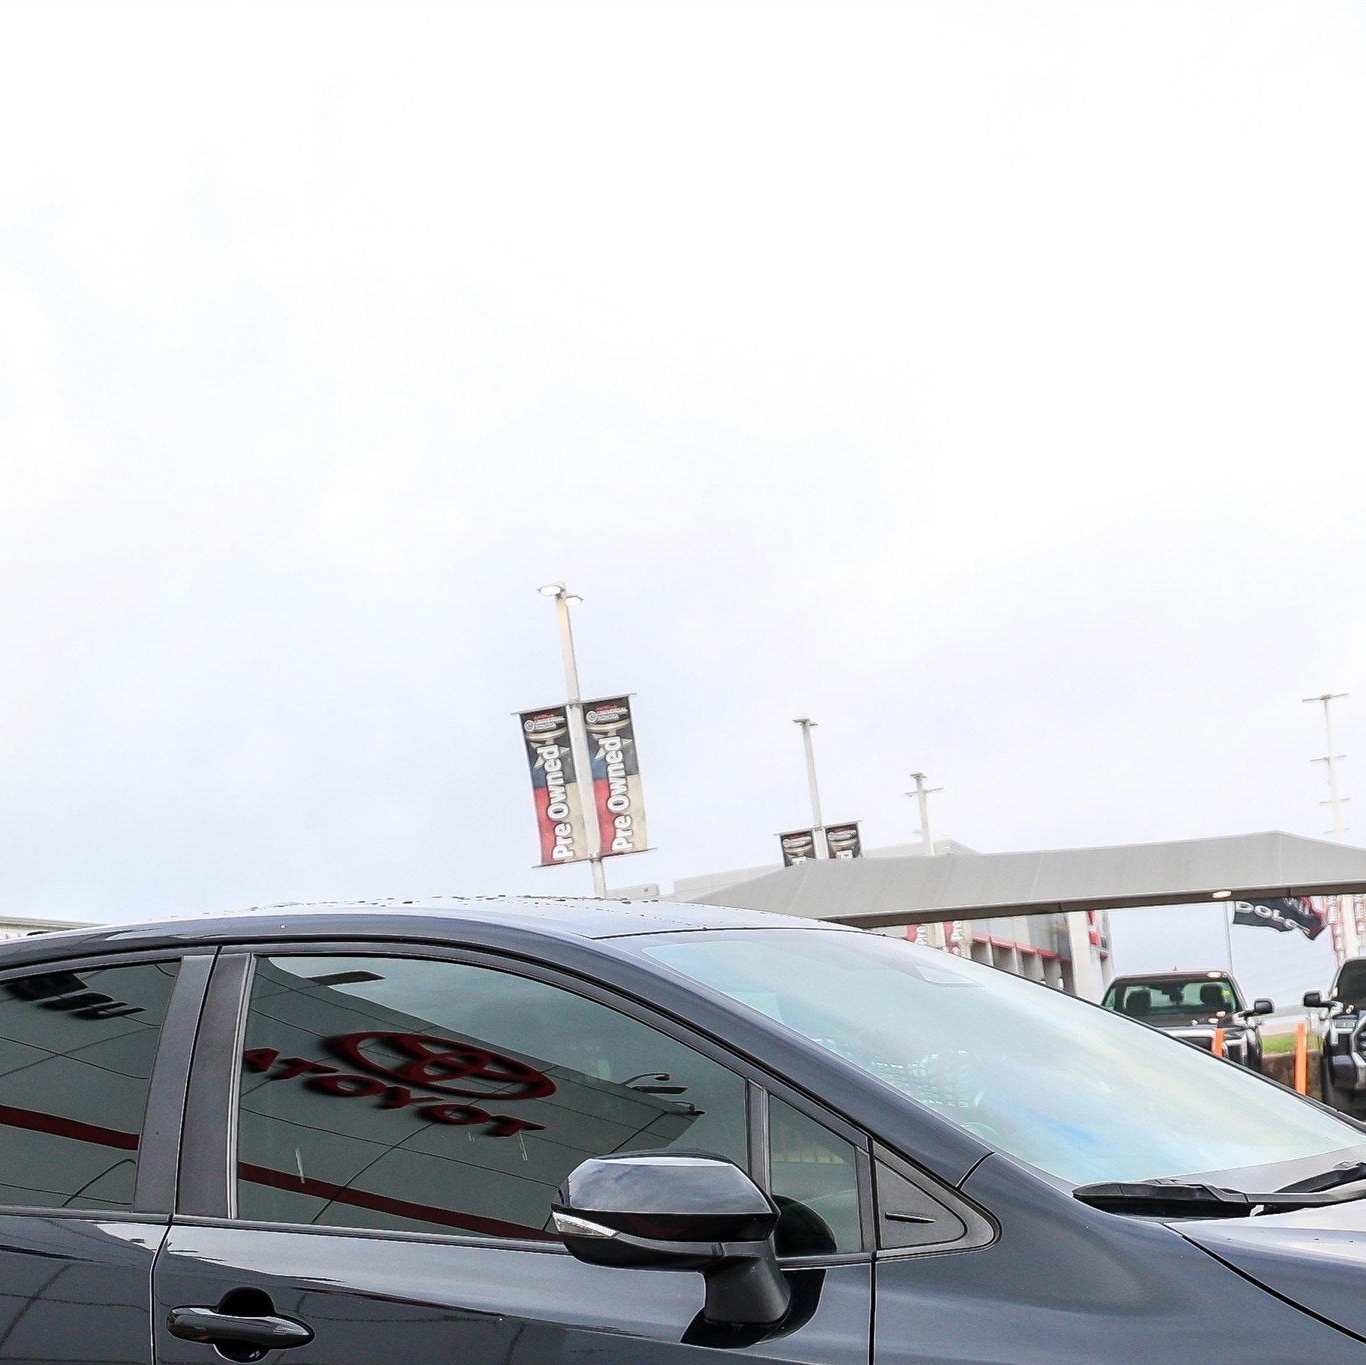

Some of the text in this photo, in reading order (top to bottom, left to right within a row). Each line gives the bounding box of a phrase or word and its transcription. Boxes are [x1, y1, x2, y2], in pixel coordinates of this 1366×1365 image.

[537, 744, 569, 821] Owned
[598, 736, 630, 813] Owned
[552, 822, 574, 860] Pre
[611, 814, 633, 851] Pre
